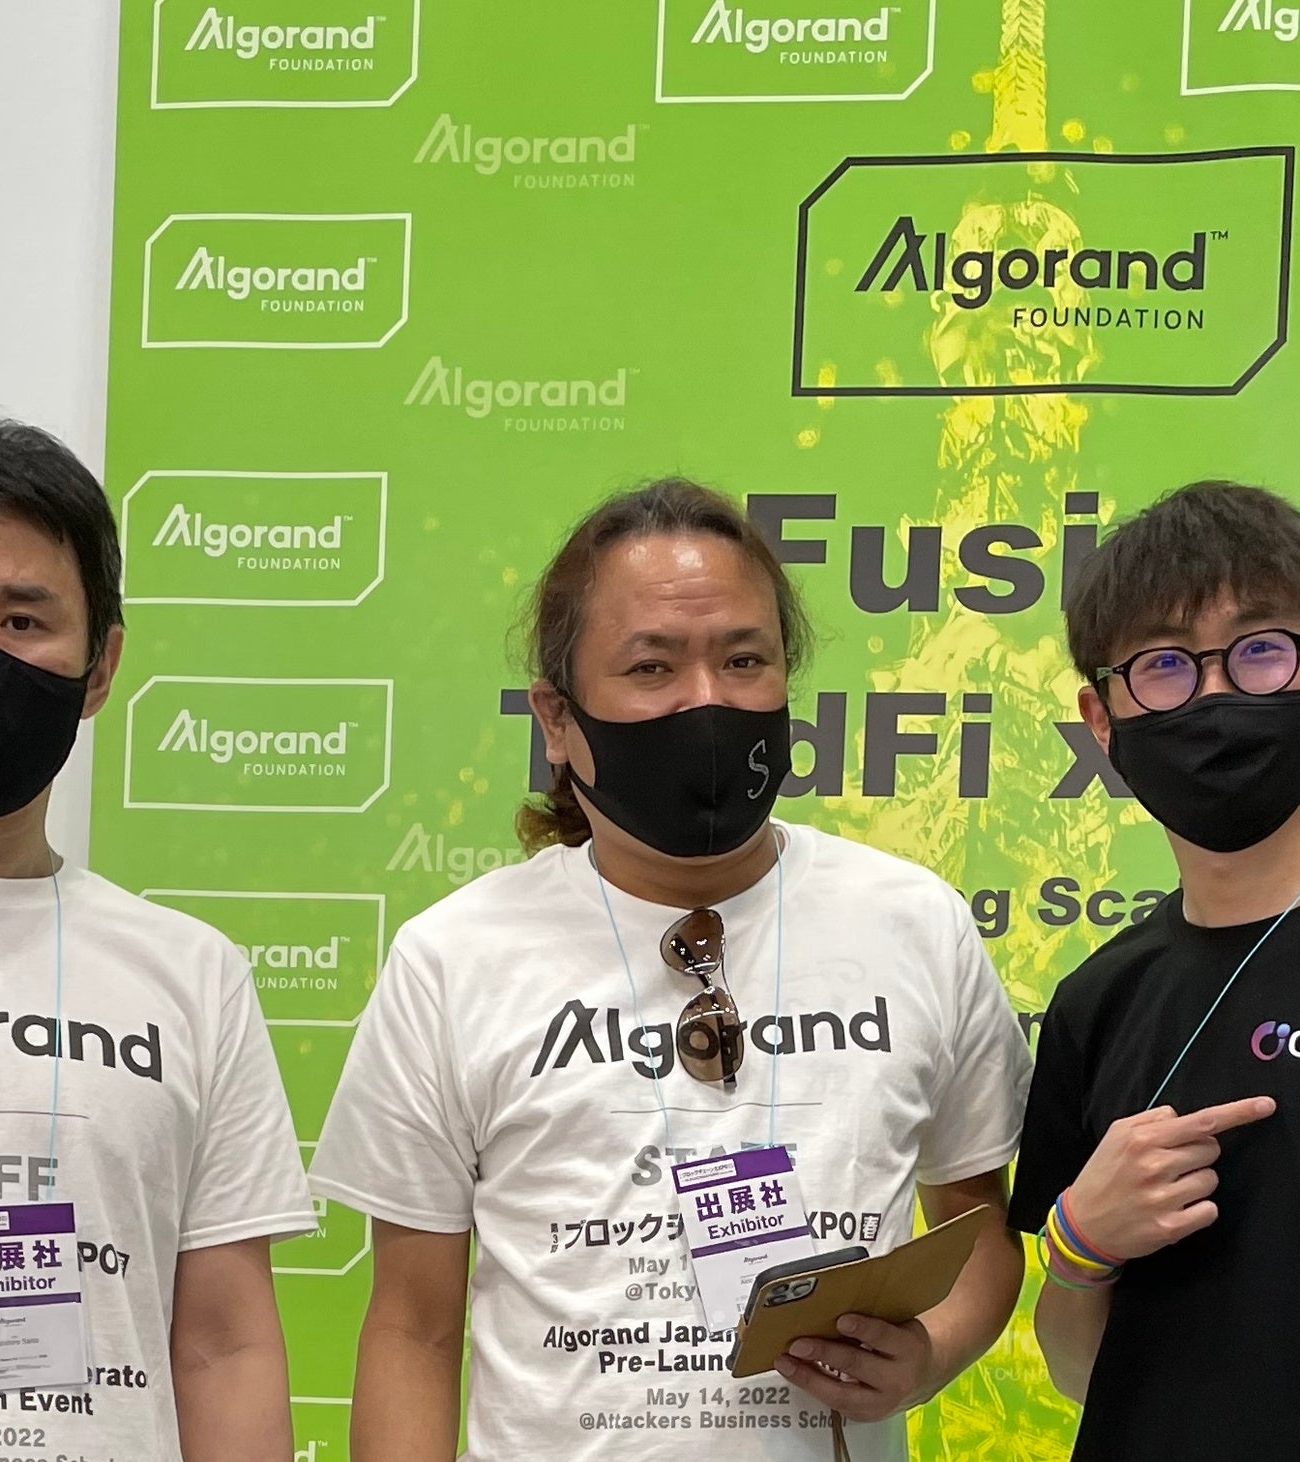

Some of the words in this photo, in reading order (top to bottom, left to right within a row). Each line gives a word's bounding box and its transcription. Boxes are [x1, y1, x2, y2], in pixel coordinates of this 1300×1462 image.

[270, 58, 374, 71] FOUNDATION
[780, 51, 887, 64] FOUNDATION
[514, 174, 635, 189] FOUNDATION
[261, 300, 364, 313] FOUNDATION
[1013, 307, 1205, 330] FOUNDATION
[504, 418, 625, 432] FOUNDATION
[746, 492, 1099, 614] Fusi
[237, 557, 340, 570] FOUNDATION
[500, 690, 992, 798] TdFi
[243, 763, 346, 776] FOUNDATION
[385, 822, 528, 885] Algor
[1038, 876, 1170, 926] Sca
[255, 977, 338, 990] UNDATION
[695, 1179, 788, 1222] 出展社
[707, 1213, 785, 1240] Exhibitor
[628, 1256, 670, 1276] May
[543, 1322, 650, 1351] Algorand
[20, 1388, 94, 1416] Event
[646, 1387, 690, 1408] May
[699, 1387, 731, 1408] 14,
[739, 1387, 790, 1405] 2022
[579, 1411, 692, 1431] @Attackers
[700, 1411, 791, 1429] Business
